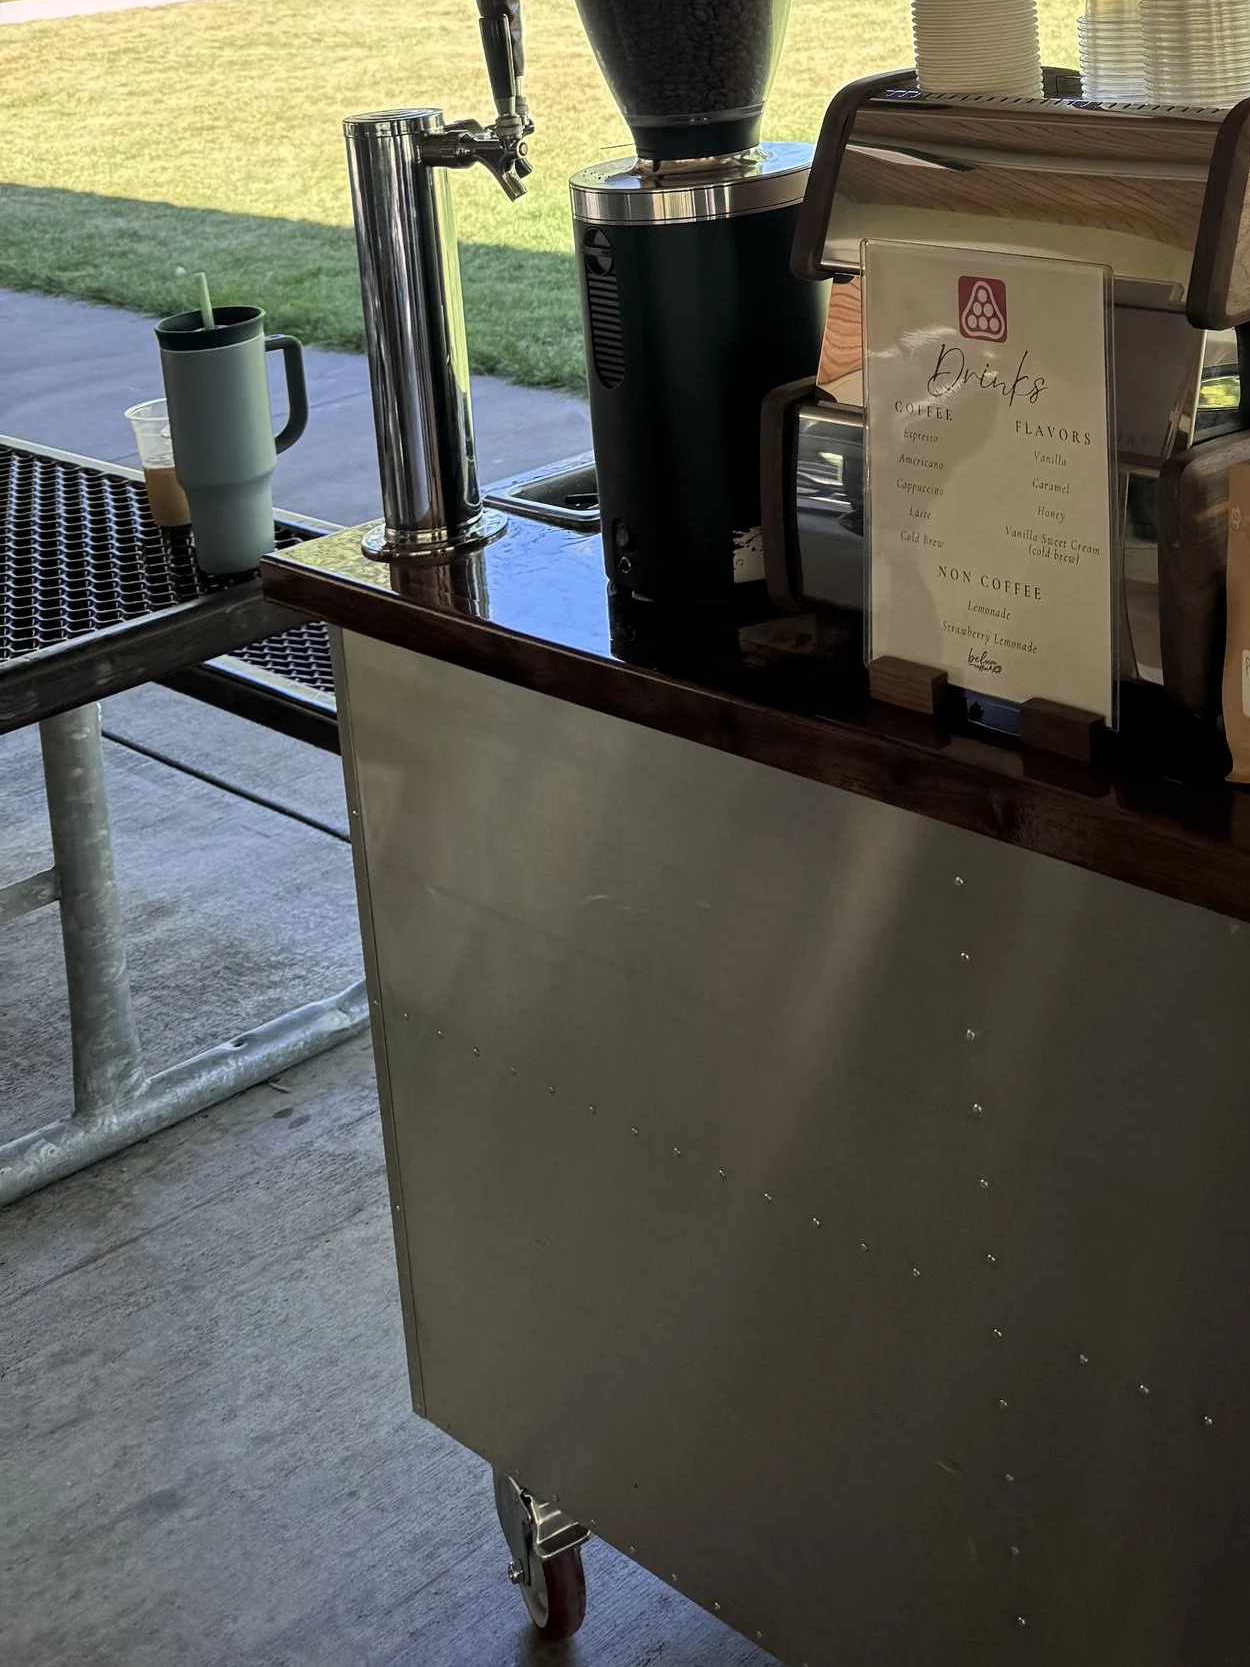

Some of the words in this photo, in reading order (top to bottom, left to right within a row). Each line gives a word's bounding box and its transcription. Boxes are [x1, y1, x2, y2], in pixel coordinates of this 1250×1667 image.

[927, 343, 1048, 407] Drinks
[894, 400, 953, 421] COFFEE
[903, 429, 938, 443] Espresso
[1015, 420, 1092, 446] FLAVORS
[899, 454, 944, 470] Americano
[1034, 450, 1067, 467] Vanilla
[896, 478, 944, 496] Cappuccino
[1032, 477, 1070, 495] Caramel
[909, 506, 932, 520] Latte
[1037, 505, 1065, 524] Honey
[900, 530, 920, 544] Cold
[923, 534, 944, 548] Brew
[1005, 525, 1038, 542] Vanilla
[1042, 533, 1067, 549] Sweet
[1070, 540, 1100, 556] Cream
[1028, 544, 1050, 559] (cold
[1054, 548, 1080, 565] brew)
[938, 565, 971, 583] NON
[980, 574, 1042, 600] COFFEE
[967, 600, 1011, 620] Lemonade
[942, 620, 991, 645] Strawberry
[994, 633, 1038, 654] Lemonade
